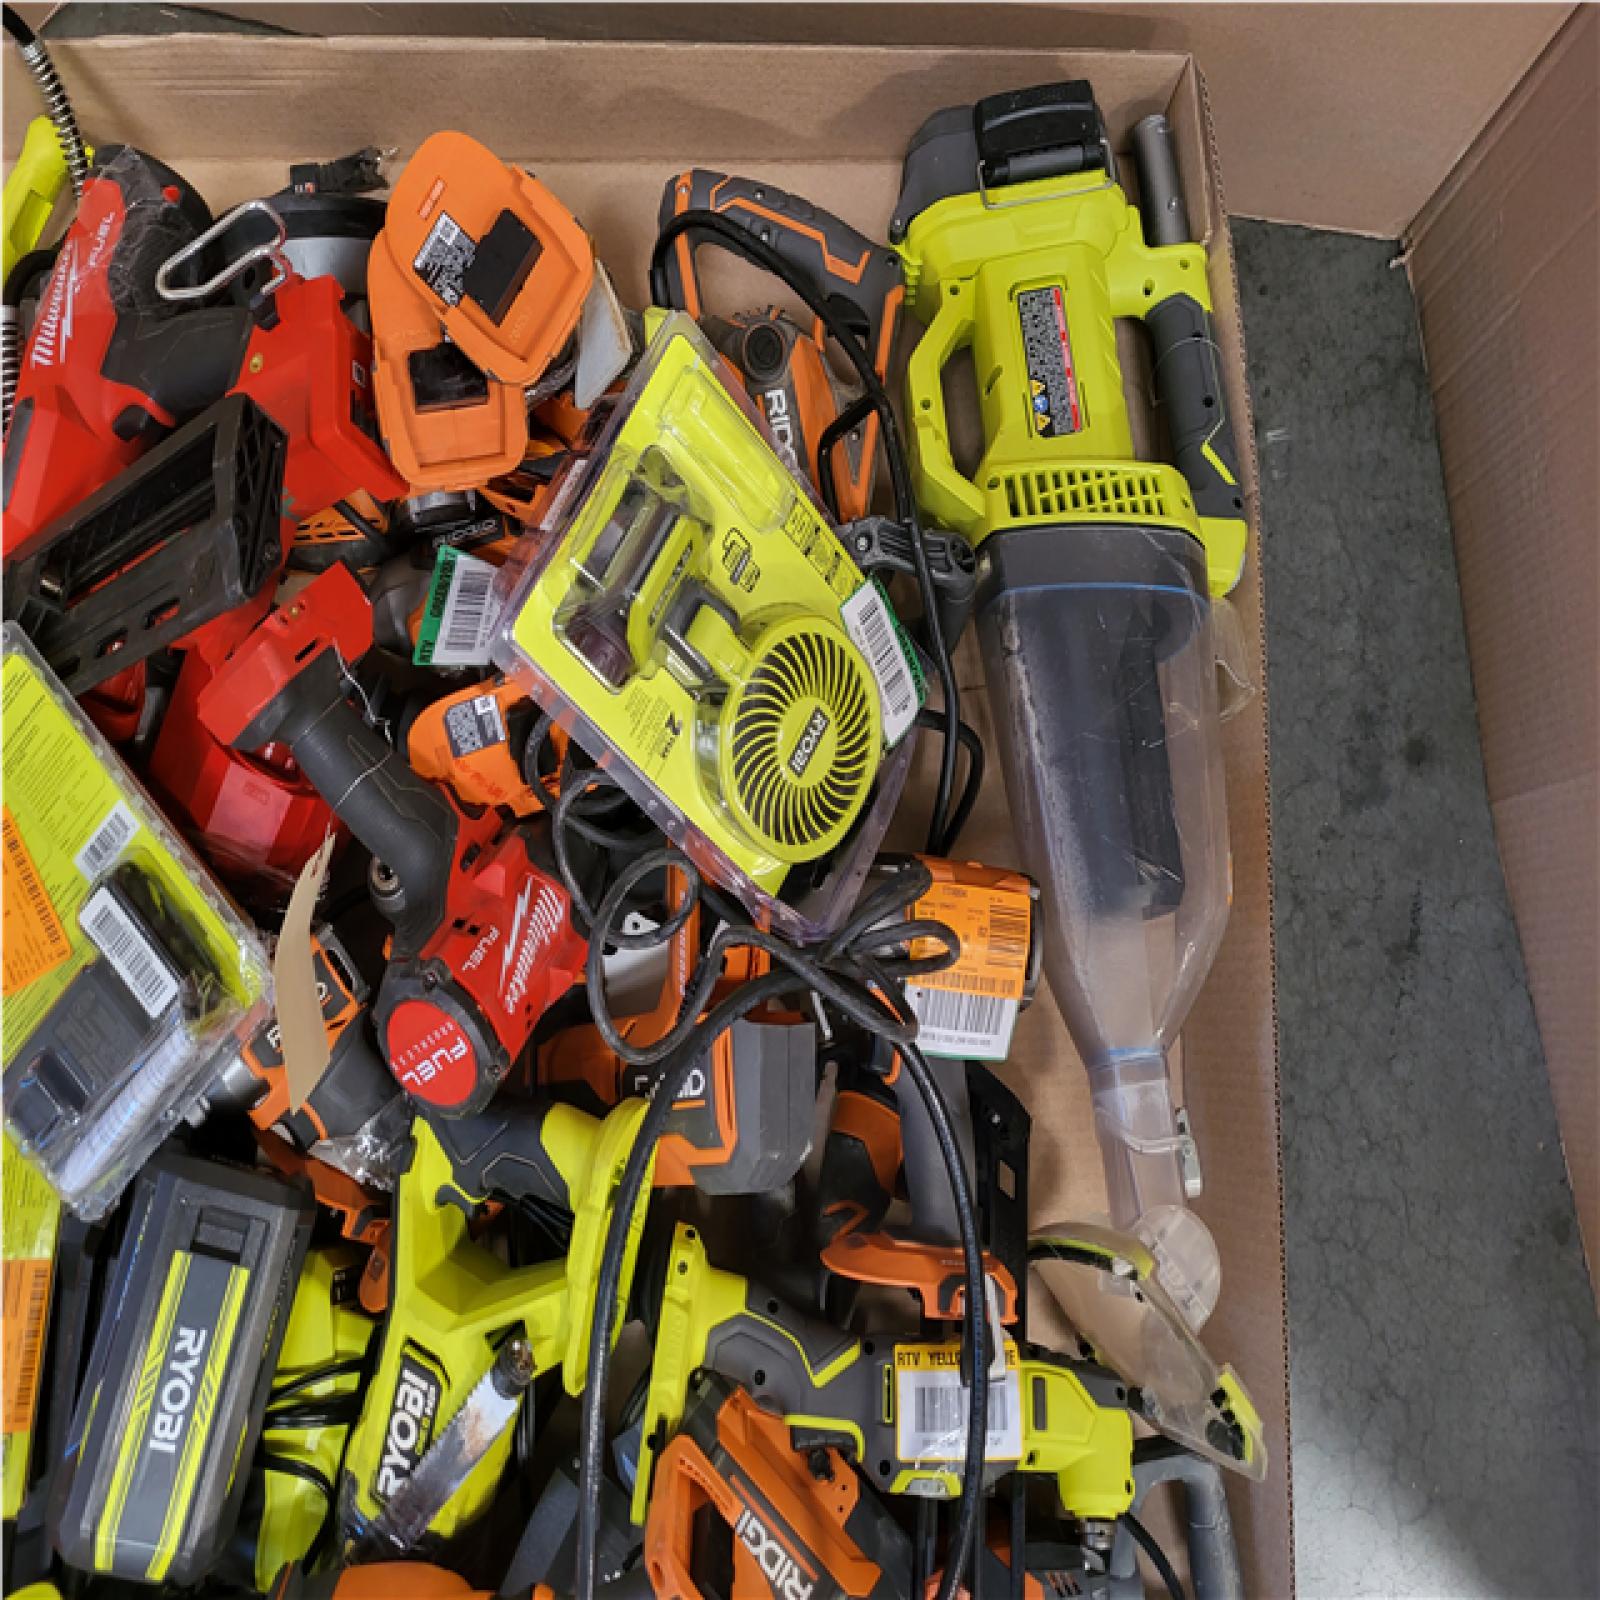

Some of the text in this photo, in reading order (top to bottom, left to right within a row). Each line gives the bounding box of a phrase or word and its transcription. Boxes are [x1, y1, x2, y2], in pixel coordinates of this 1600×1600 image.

[789, 706, 830, 775] RYOBI
[462, 924, 499, 972] FUEL
[503, 885, 565, 1015] Milwaukee
[402, 1037, 469, 1086] FUEL
[149, 1326, 207, 1453] RYOBI
[897, 1351, 920, 1366] RTV
[377, 1369, 428, 1496] RYOBI
[735, 1508, 814, 1600] RIDGI
